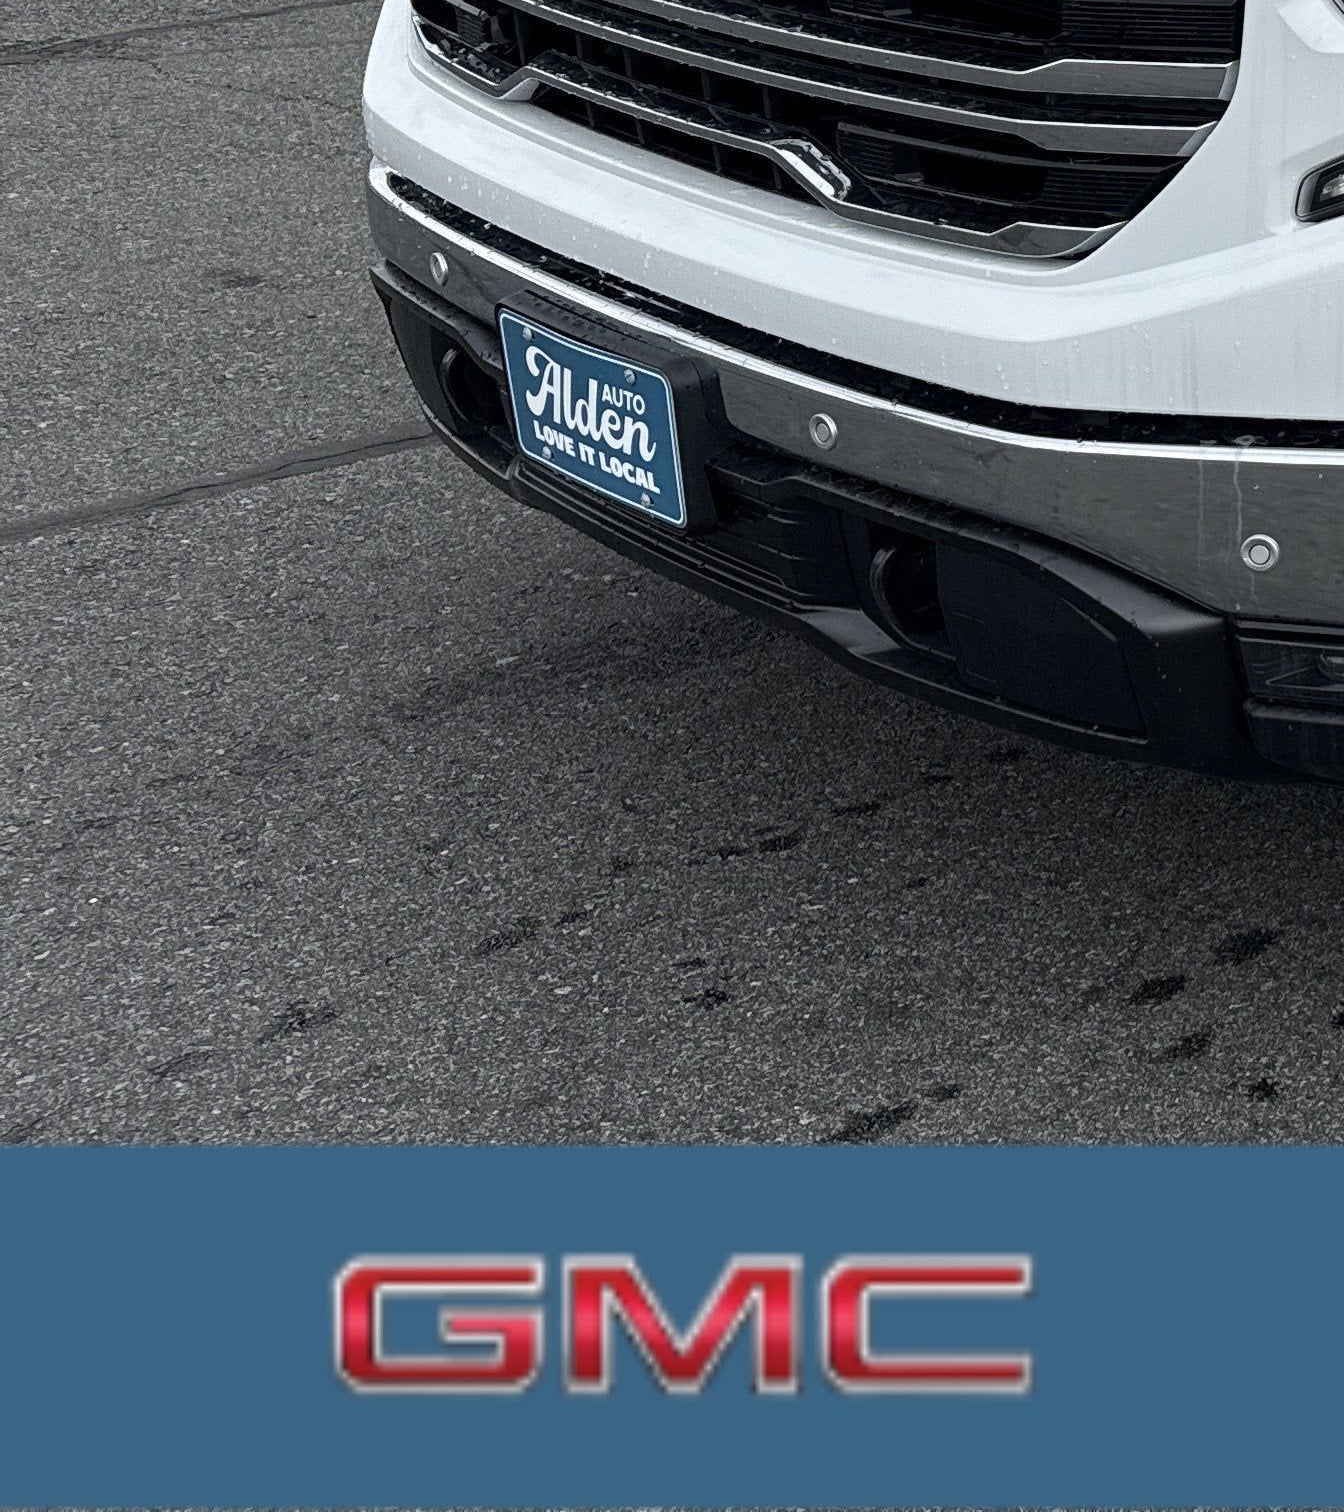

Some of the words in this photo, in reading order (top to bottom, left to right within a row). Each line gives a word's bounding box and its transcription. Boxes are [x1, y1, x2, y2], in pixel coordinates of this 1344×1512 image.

[525, 345, 656, 462] Alden
[602, 384, 645, 415] AUTO
[533, 419, 575, 458] LOVE
[577, 442, 596, 467] IT
[598, 452, 661, 494] LOCAL
